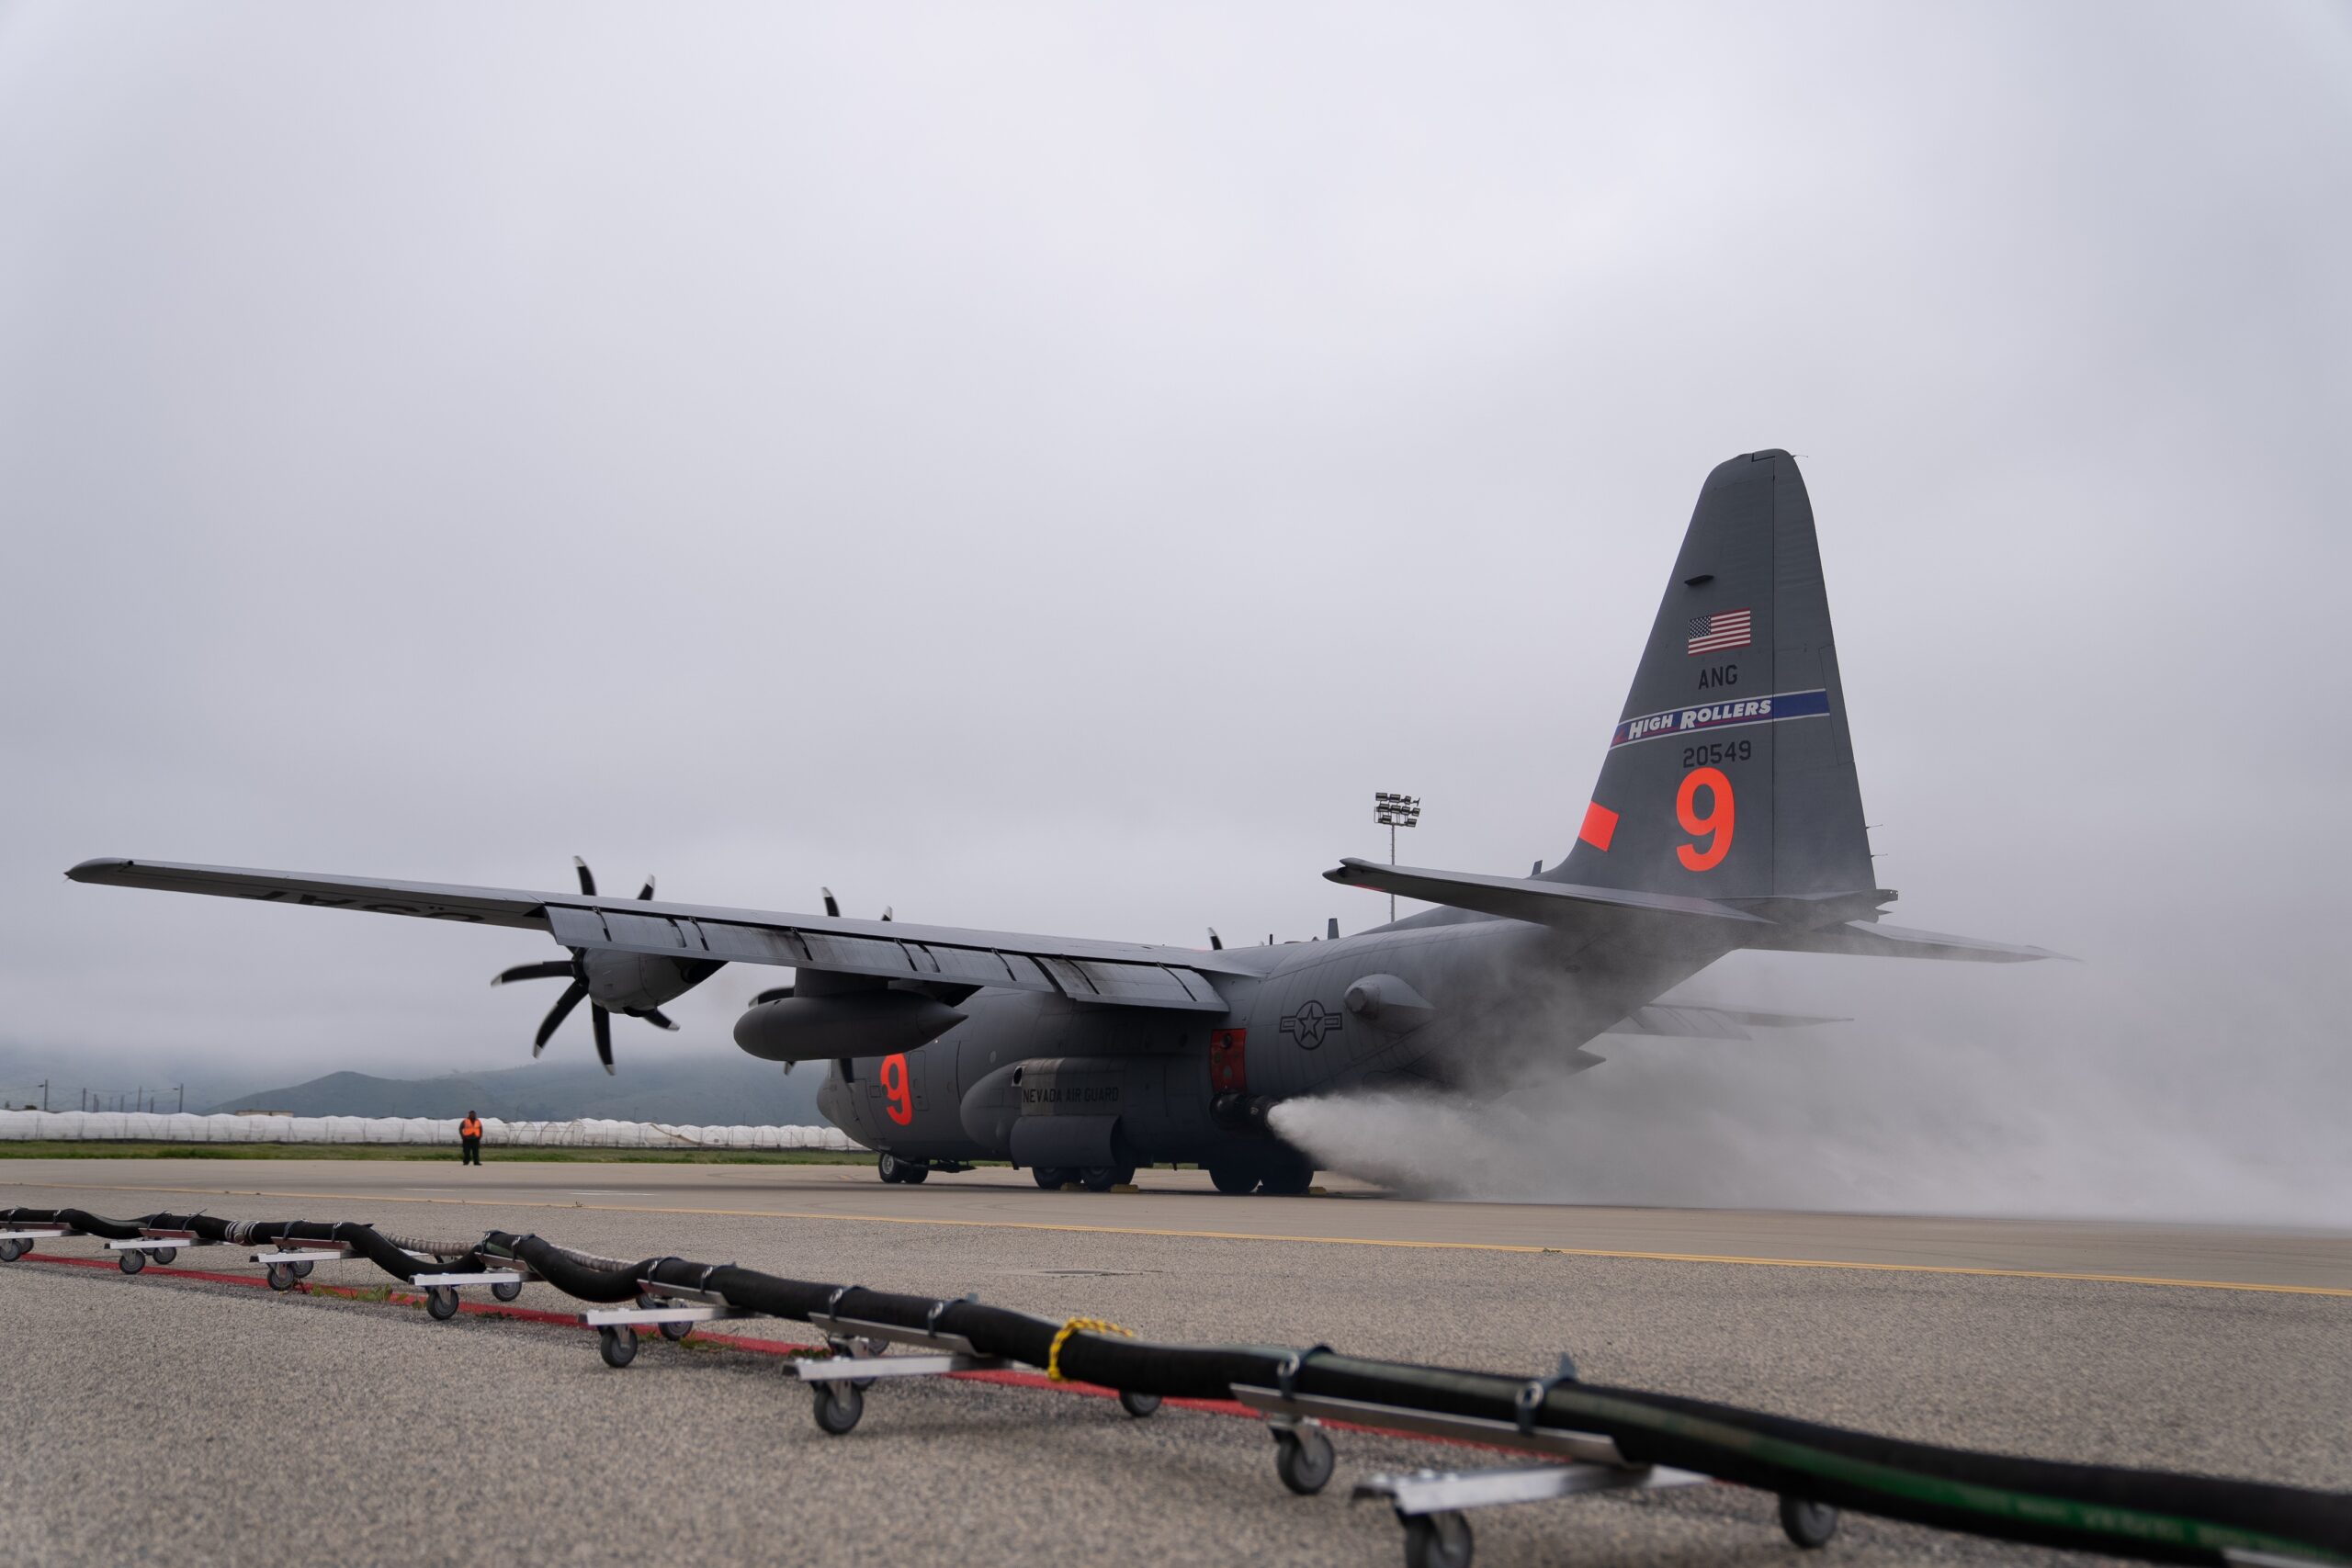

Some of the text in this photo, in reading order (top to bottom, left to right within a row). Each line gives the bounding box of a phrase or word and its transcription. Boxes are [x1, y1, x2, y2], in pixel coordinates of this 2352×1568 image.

[1698, 664, 1738, 690] ANG
[1628, 699, 1772, 740] HIGH ROLLERS
[1683, 740, 1751, 769] 20549
[1676, 766, 1736, 873] 9
[880, 1053, 913, 1127] 9
[1023, 1087, 1119, 1103] NEVADA AIR GUARD
